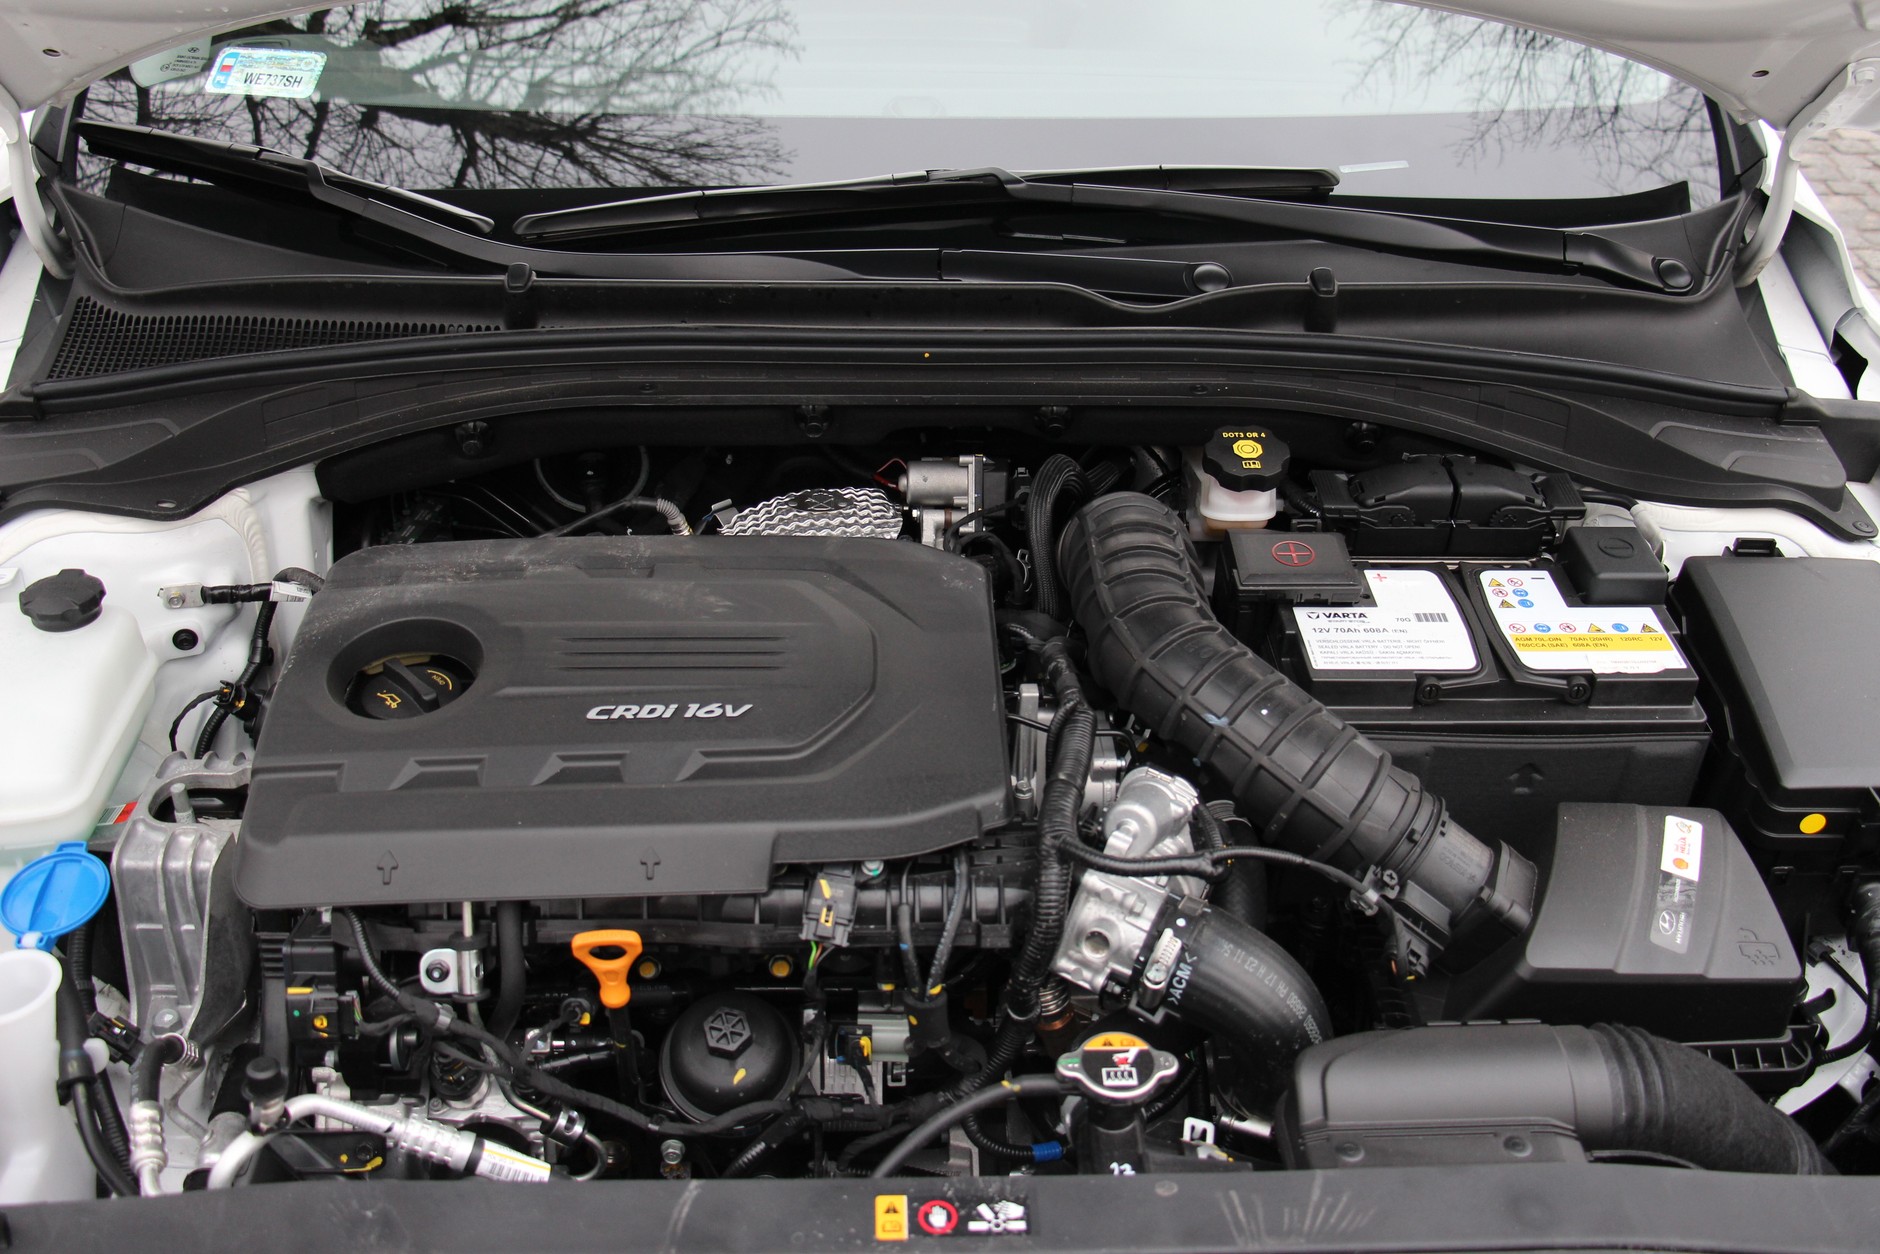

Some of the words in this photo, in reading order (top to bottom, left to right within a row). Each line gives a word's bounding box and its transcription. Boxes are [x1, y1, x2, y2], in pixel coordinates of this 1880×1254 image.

[214, 75, 227, 85] PL
[243, 72, 304, 88] WE737SH
[684, 703, 753, 718] 16V
